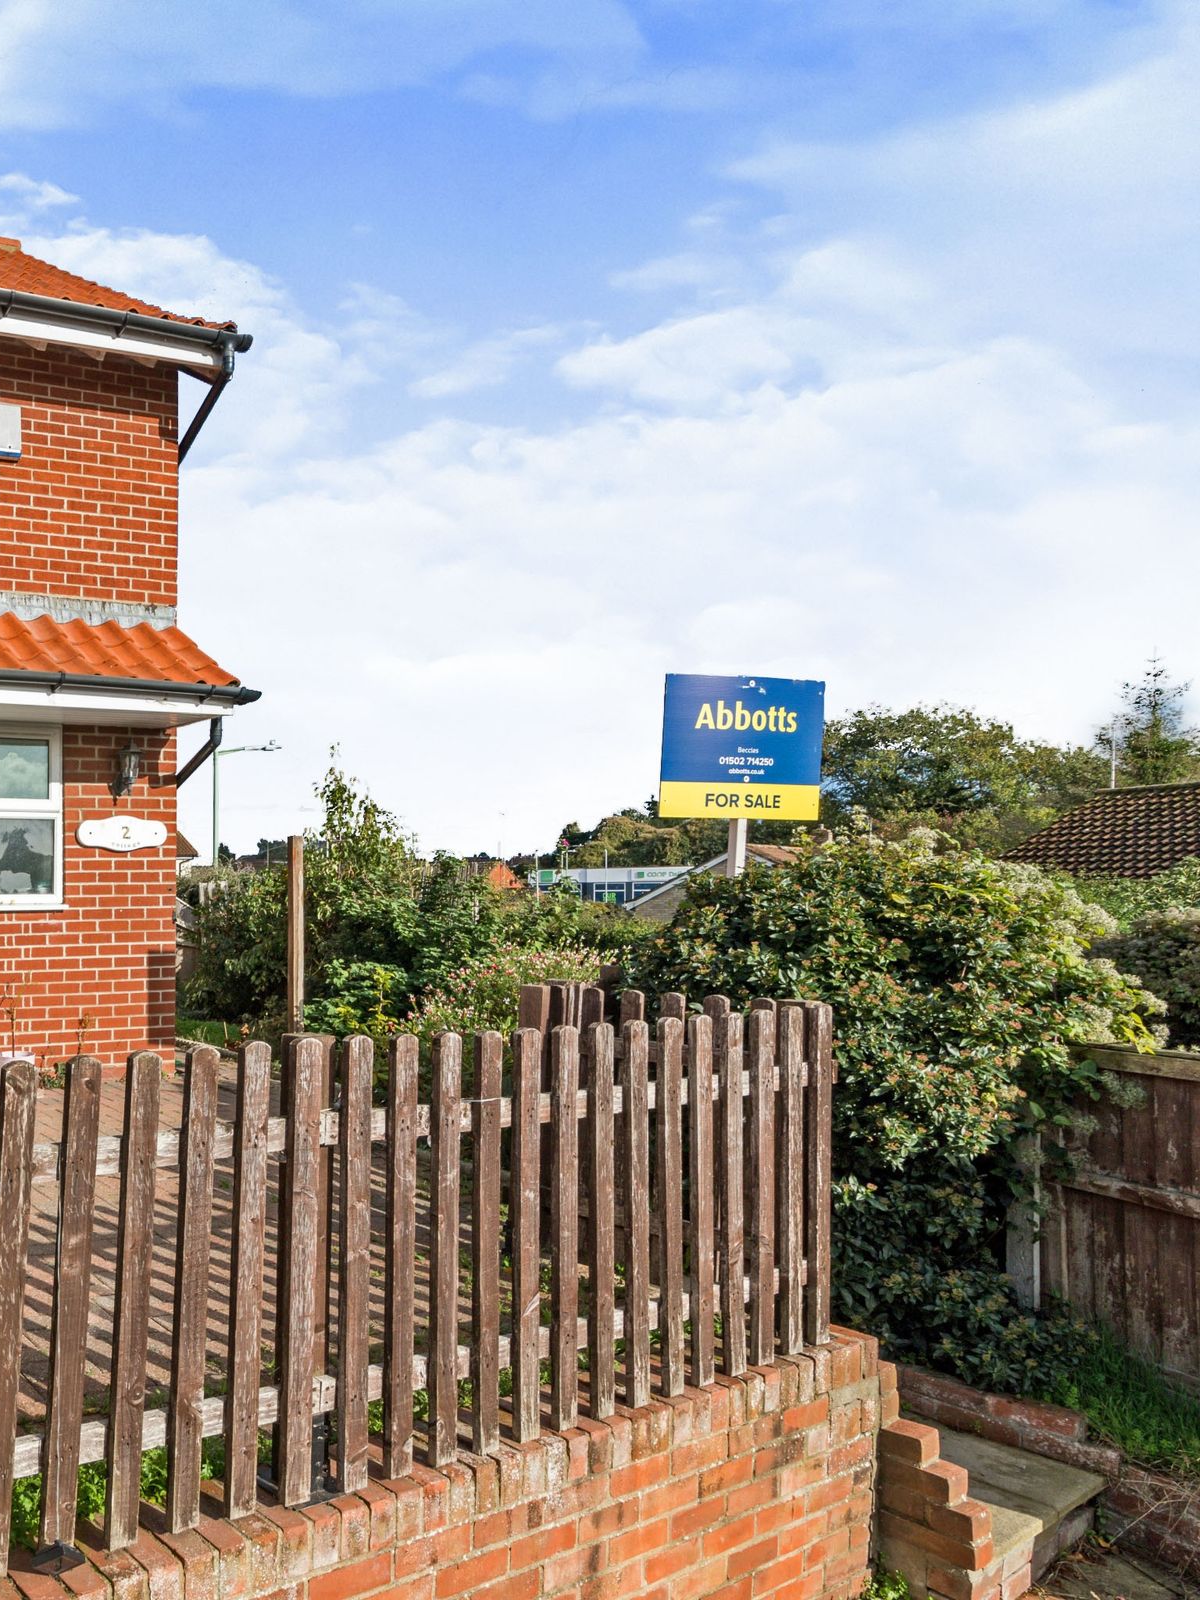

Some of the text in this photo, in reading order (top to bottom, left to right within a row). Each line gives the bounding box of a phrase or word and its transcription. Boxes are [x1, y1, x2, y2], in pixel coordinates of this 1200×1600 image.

[694, 700, 798, 733] Abbotts
[737, 746, 759, 754] Beccles
[719, 756, 774, 767] 01502 714250
[704, 793, 781, 809] FOR SALE
[121, 826, 131, 840] 2
